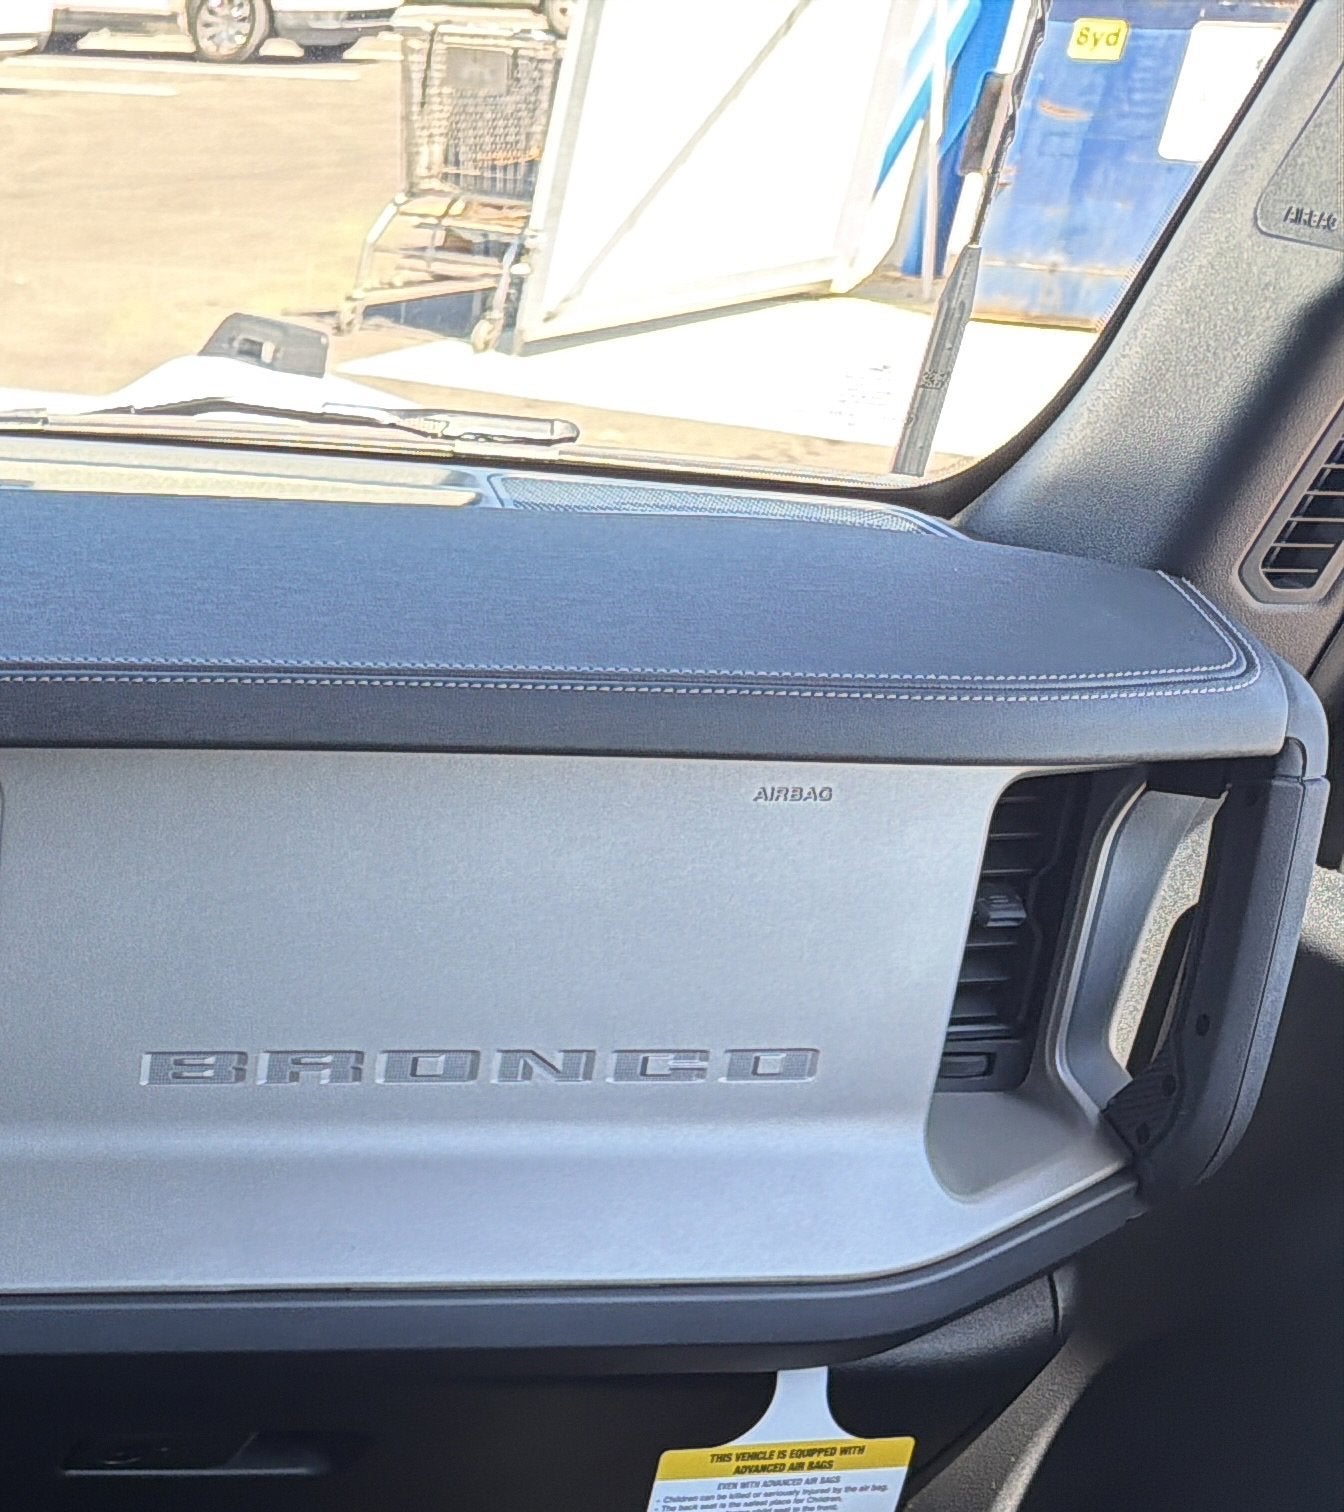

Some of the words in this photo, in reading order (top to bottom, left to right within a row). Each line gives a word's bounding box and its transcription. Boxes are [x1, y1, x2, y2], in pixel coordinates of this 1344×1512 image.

[752, 786, 833, 802] AIRBAG
[139, 1048, 821, 1086] BRONCO
[710, 1452, 733, 1464] THIS
[735, 1450, 775, 1462] VEHICLE
[777, 1449, 788, 1460] IS
[789, 1446, 837, 1459] EQUIPPED
[839, 1445, 866, 1456] WITH
[733, 1462, 787, 1475] ADVANCED
[788, 1461, 805, 1472] AIR
[807, 1460, 834, 1471] BAGS
[761, 1478, 803, 1488] ADVANCED
